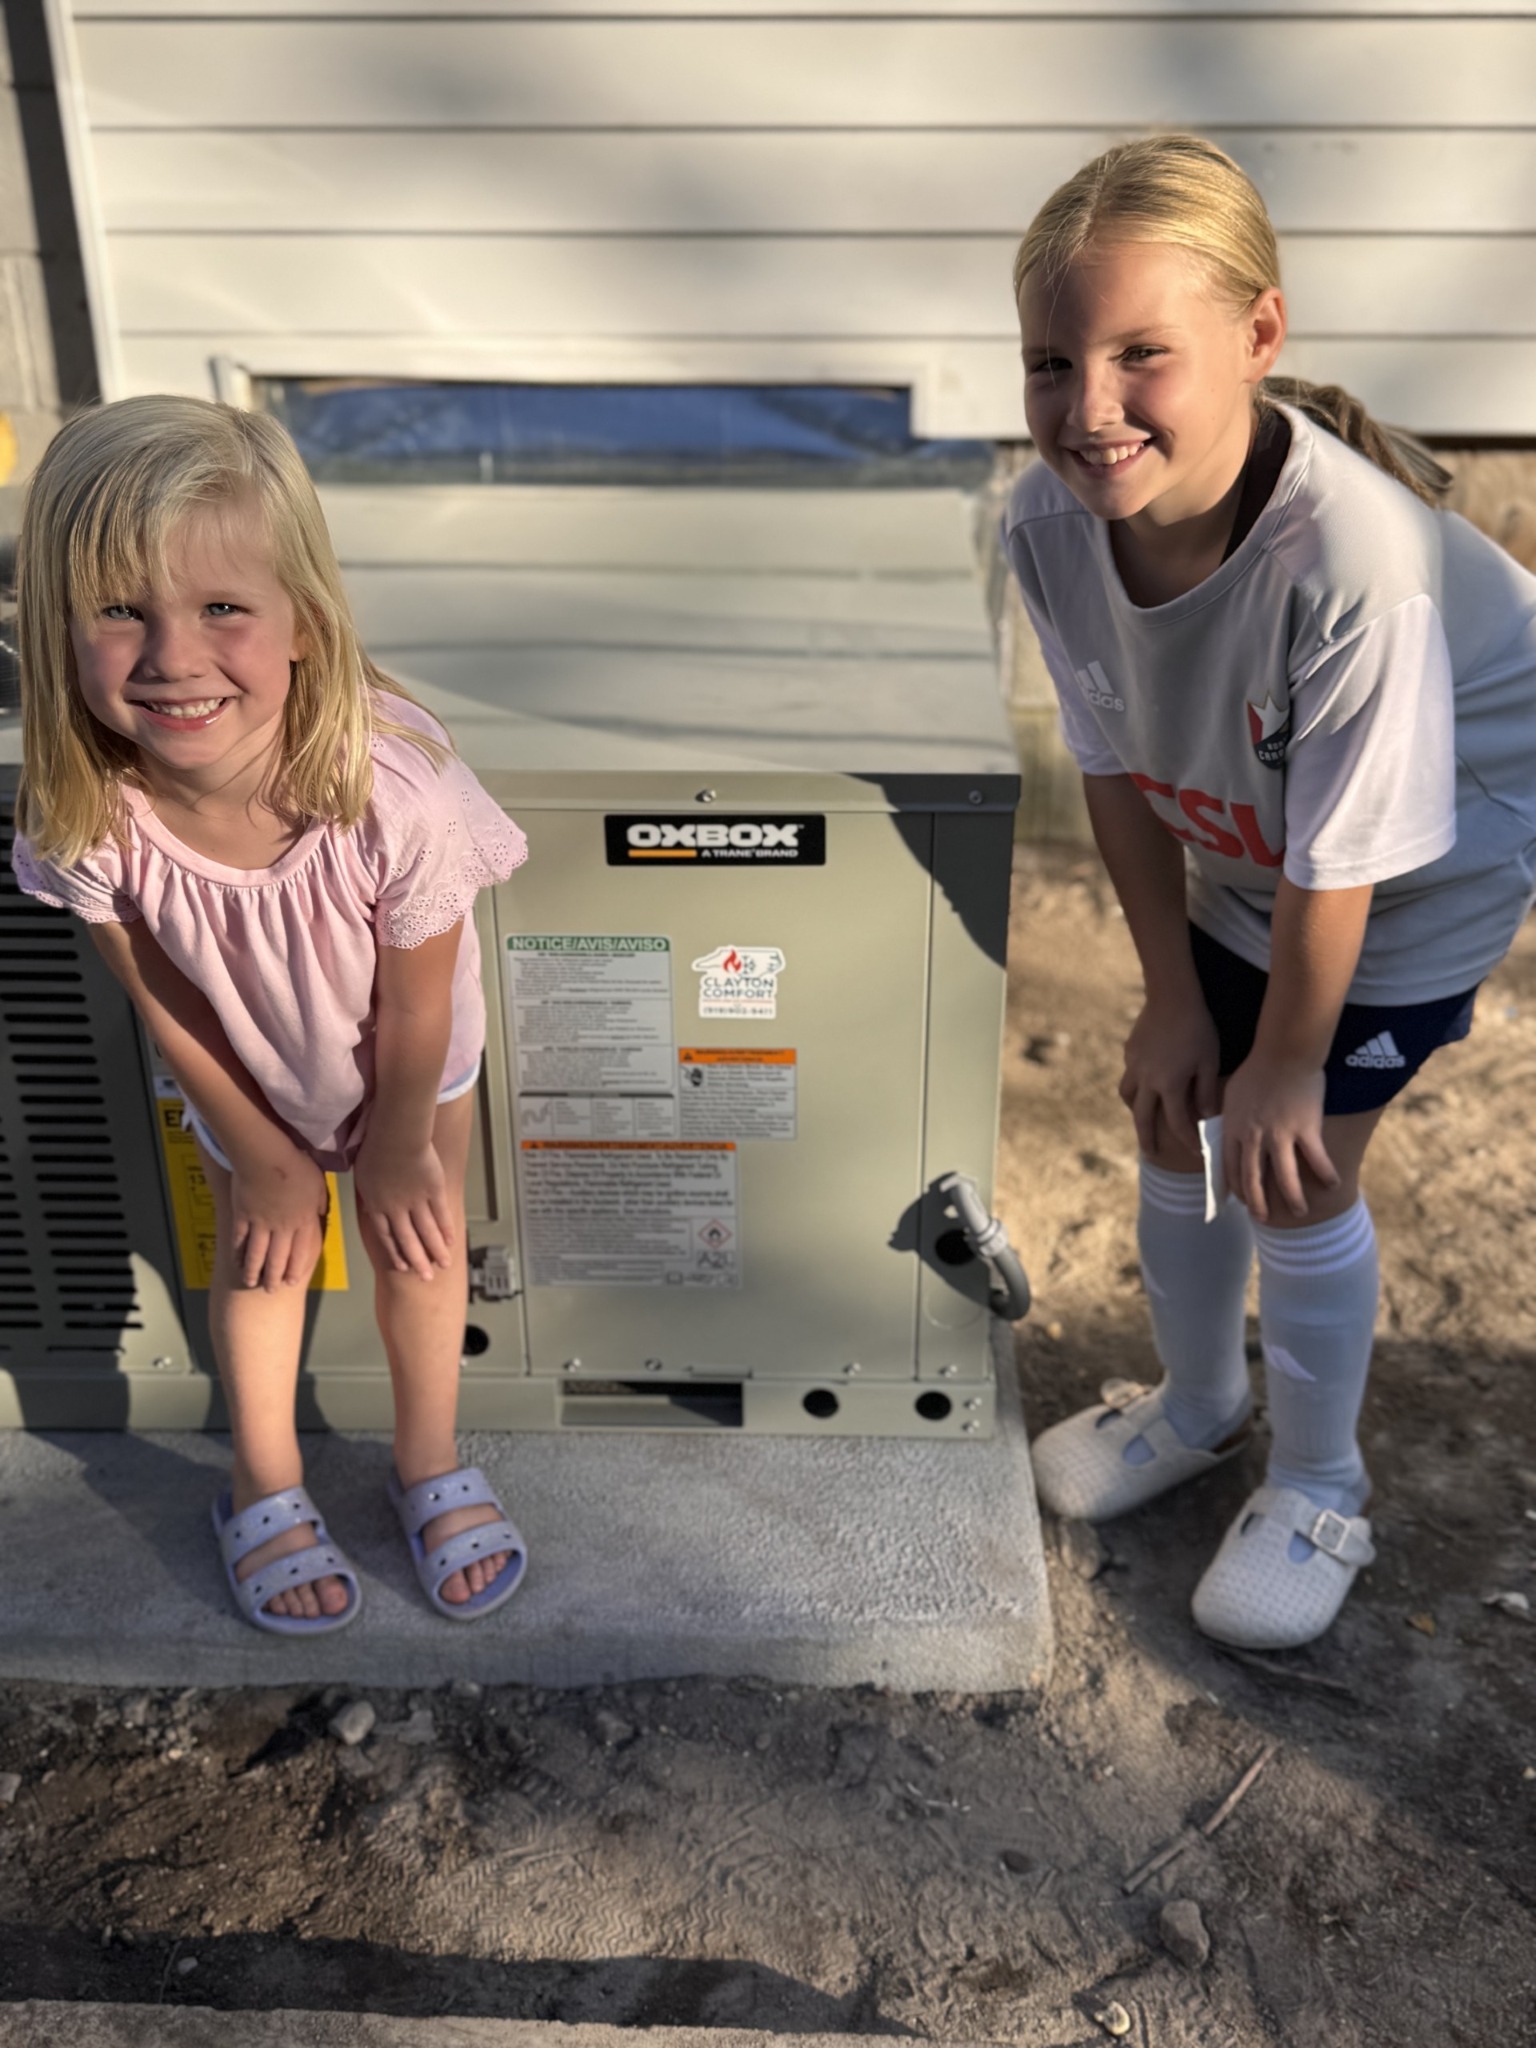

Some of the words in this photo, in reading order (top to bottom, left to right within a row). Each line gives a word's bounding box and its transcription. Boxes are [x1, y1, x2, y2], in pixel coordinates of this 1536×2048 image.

[626, 823, 800, 848] OXBOX
[702, 849, 711, 858] A
[713, 849, 753, 858] TRANE
[755, 849, 799, 858] BRAND
[512, 937, 667, 951] NOTICE/AVIS/AVISO
[704, 977, 774, 988] CLAYTON
[703, 988, 772, 998] COMFORT
[1345, 1054, 1406, 1069] adidas
